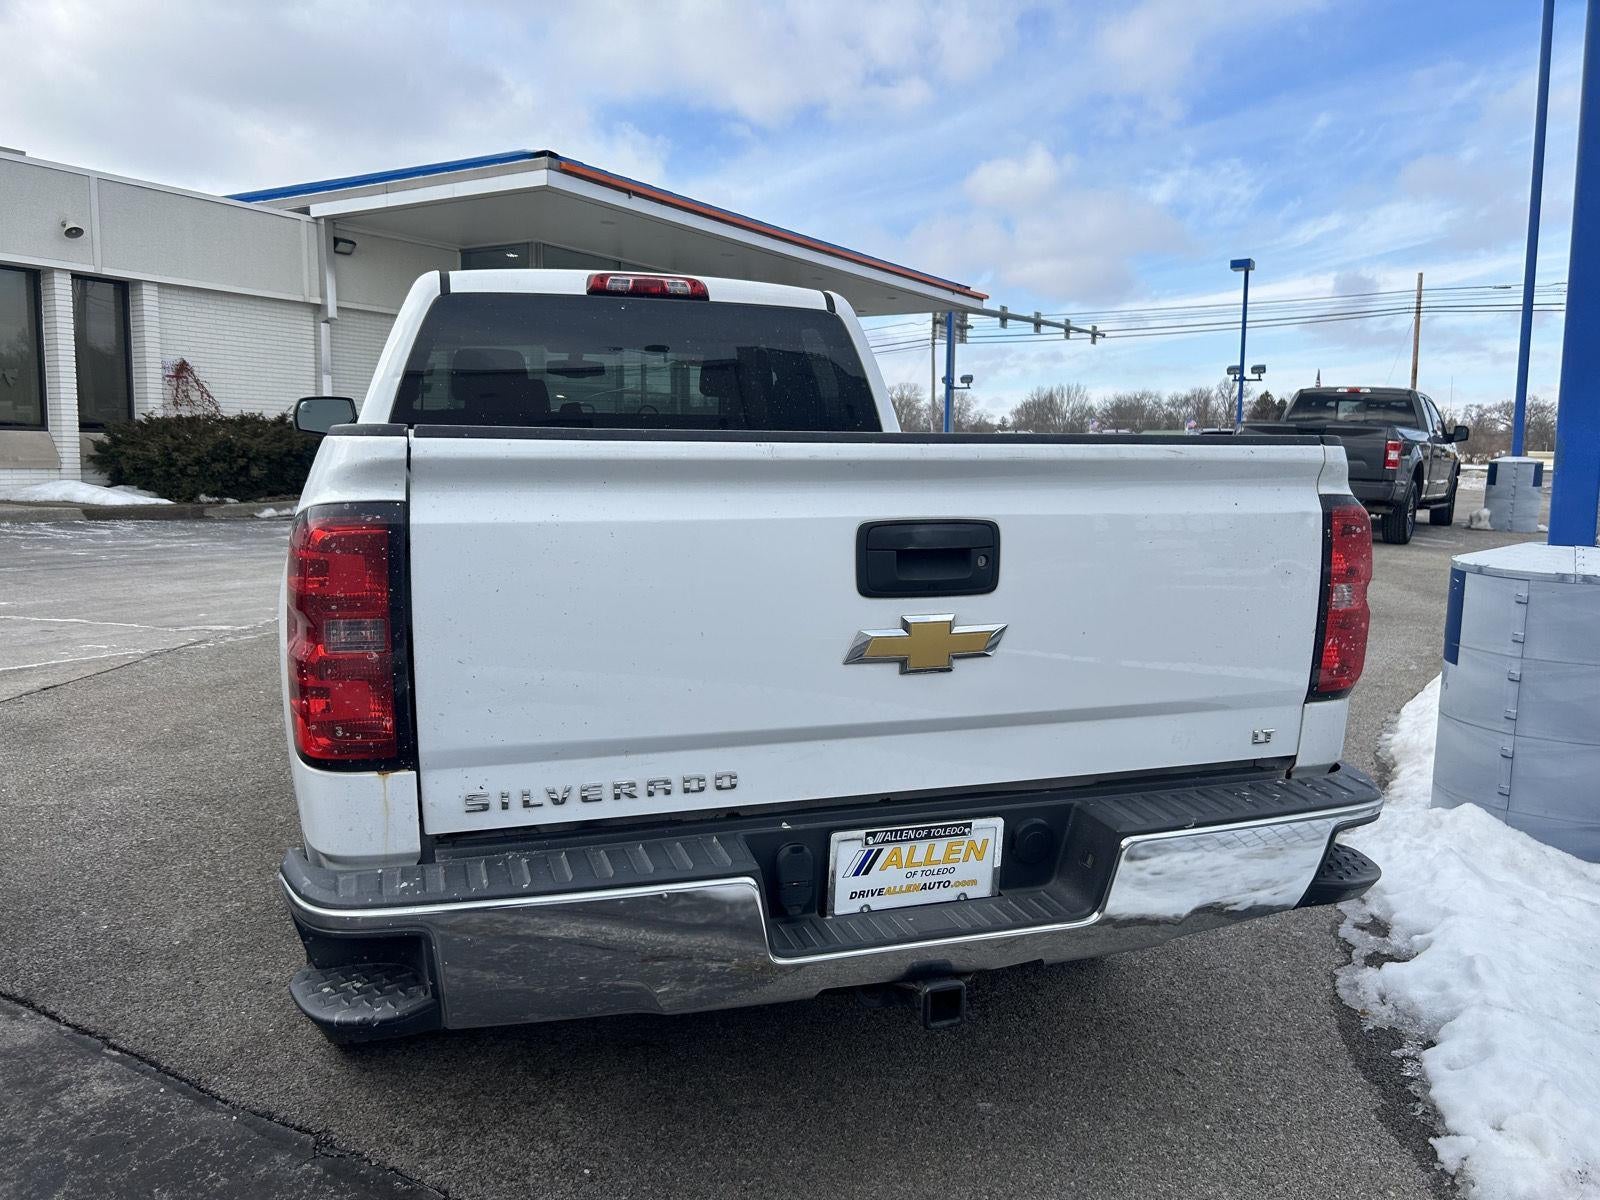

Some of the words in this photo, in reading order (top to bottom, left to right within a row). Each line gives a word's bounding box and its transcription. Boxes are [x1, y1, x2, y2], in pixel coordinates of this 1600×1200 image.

[1252, 728, 1276, 744] LT
[464, 770, 739, 814] SILVERADO
[884, 831, 915, 843] ALLEN
[916, 829, 928, 839] OF
[930, 826, 965, 838] TOLEDO
[879, 838, 989, 871] ALLEN
[905, 870, 918, 879] OF
[919, 866, 956, 878] TOLEDO
